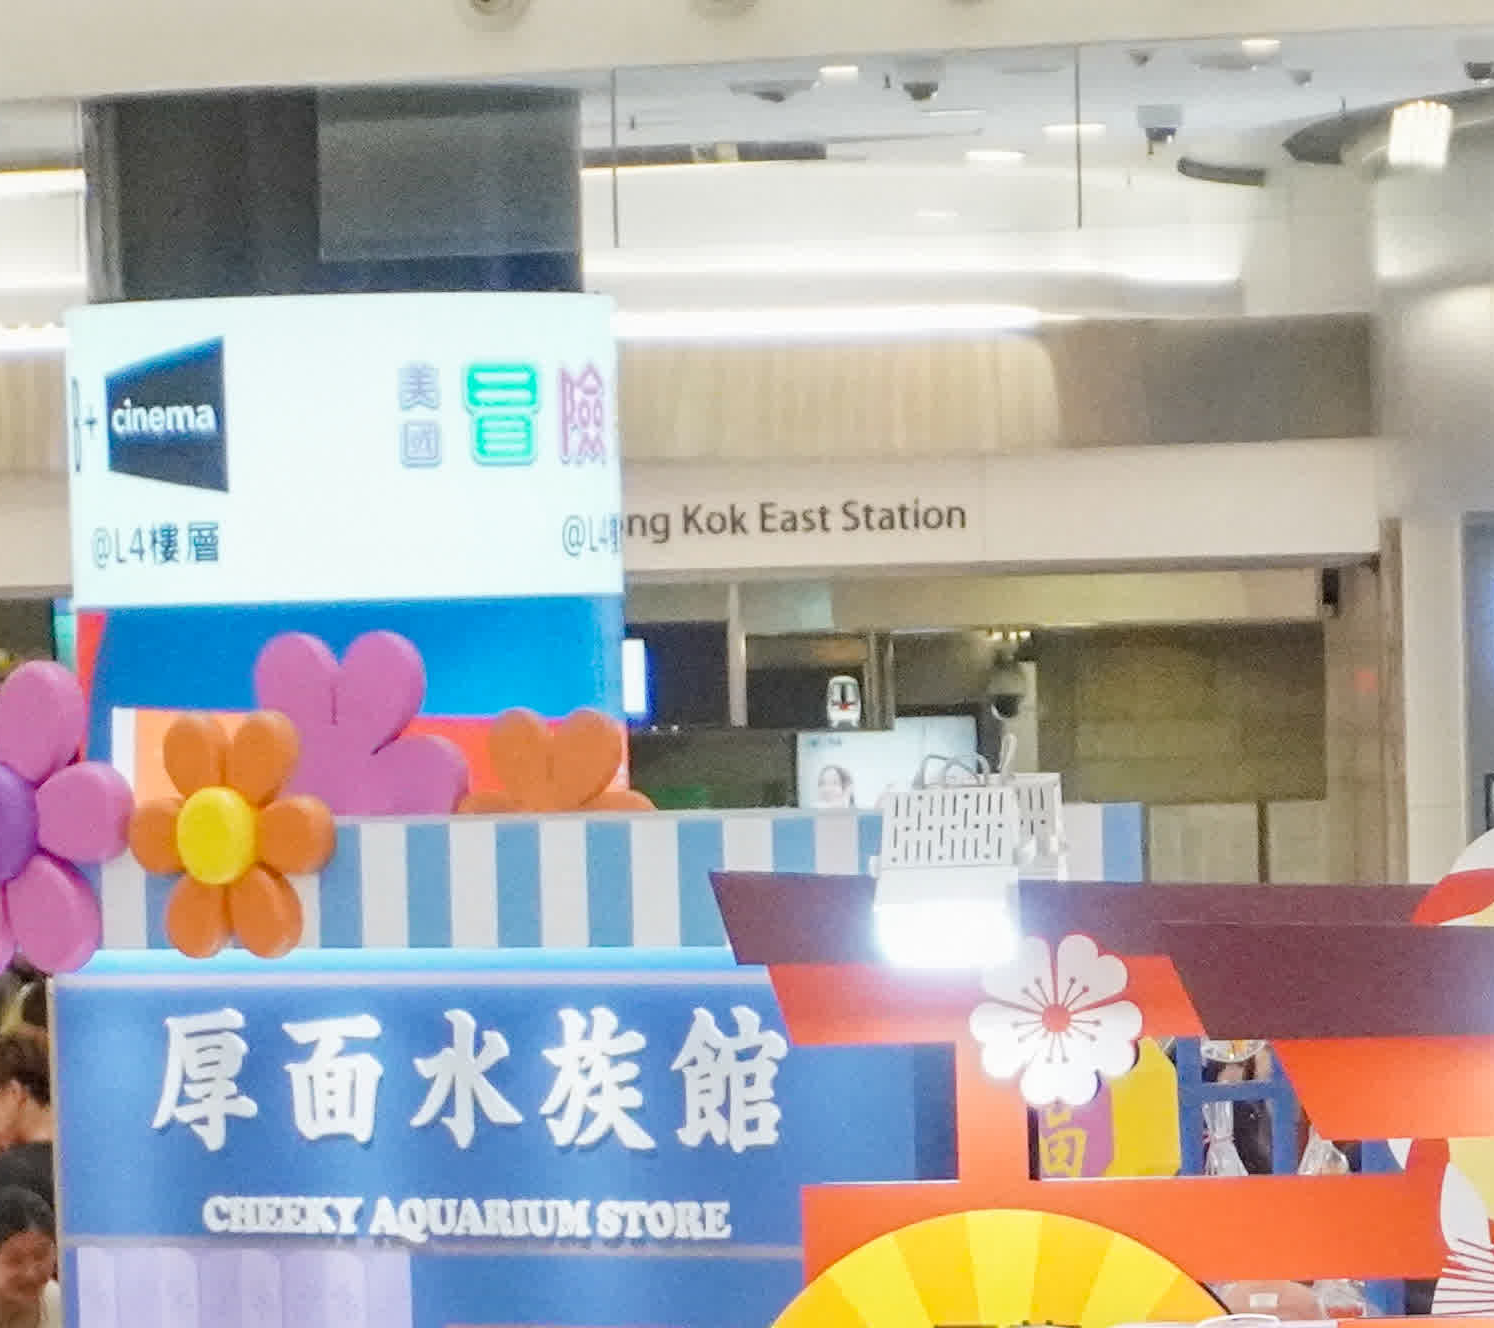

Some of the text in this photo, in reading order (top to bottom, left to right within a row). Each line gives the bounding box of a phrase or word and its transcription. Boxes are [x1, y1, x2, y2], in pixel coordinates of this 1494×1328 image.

[109, 394, 218, 436] cinema
[682, 502, 747, 537] Kok
[760, 502, 830, 534] East
[842, 498, 967, 534] Station
[151, 1006, 790, 1154] 厚面水族館
[203, 1195, 732, 1243] CHEEKY AQUARIUM STORE
